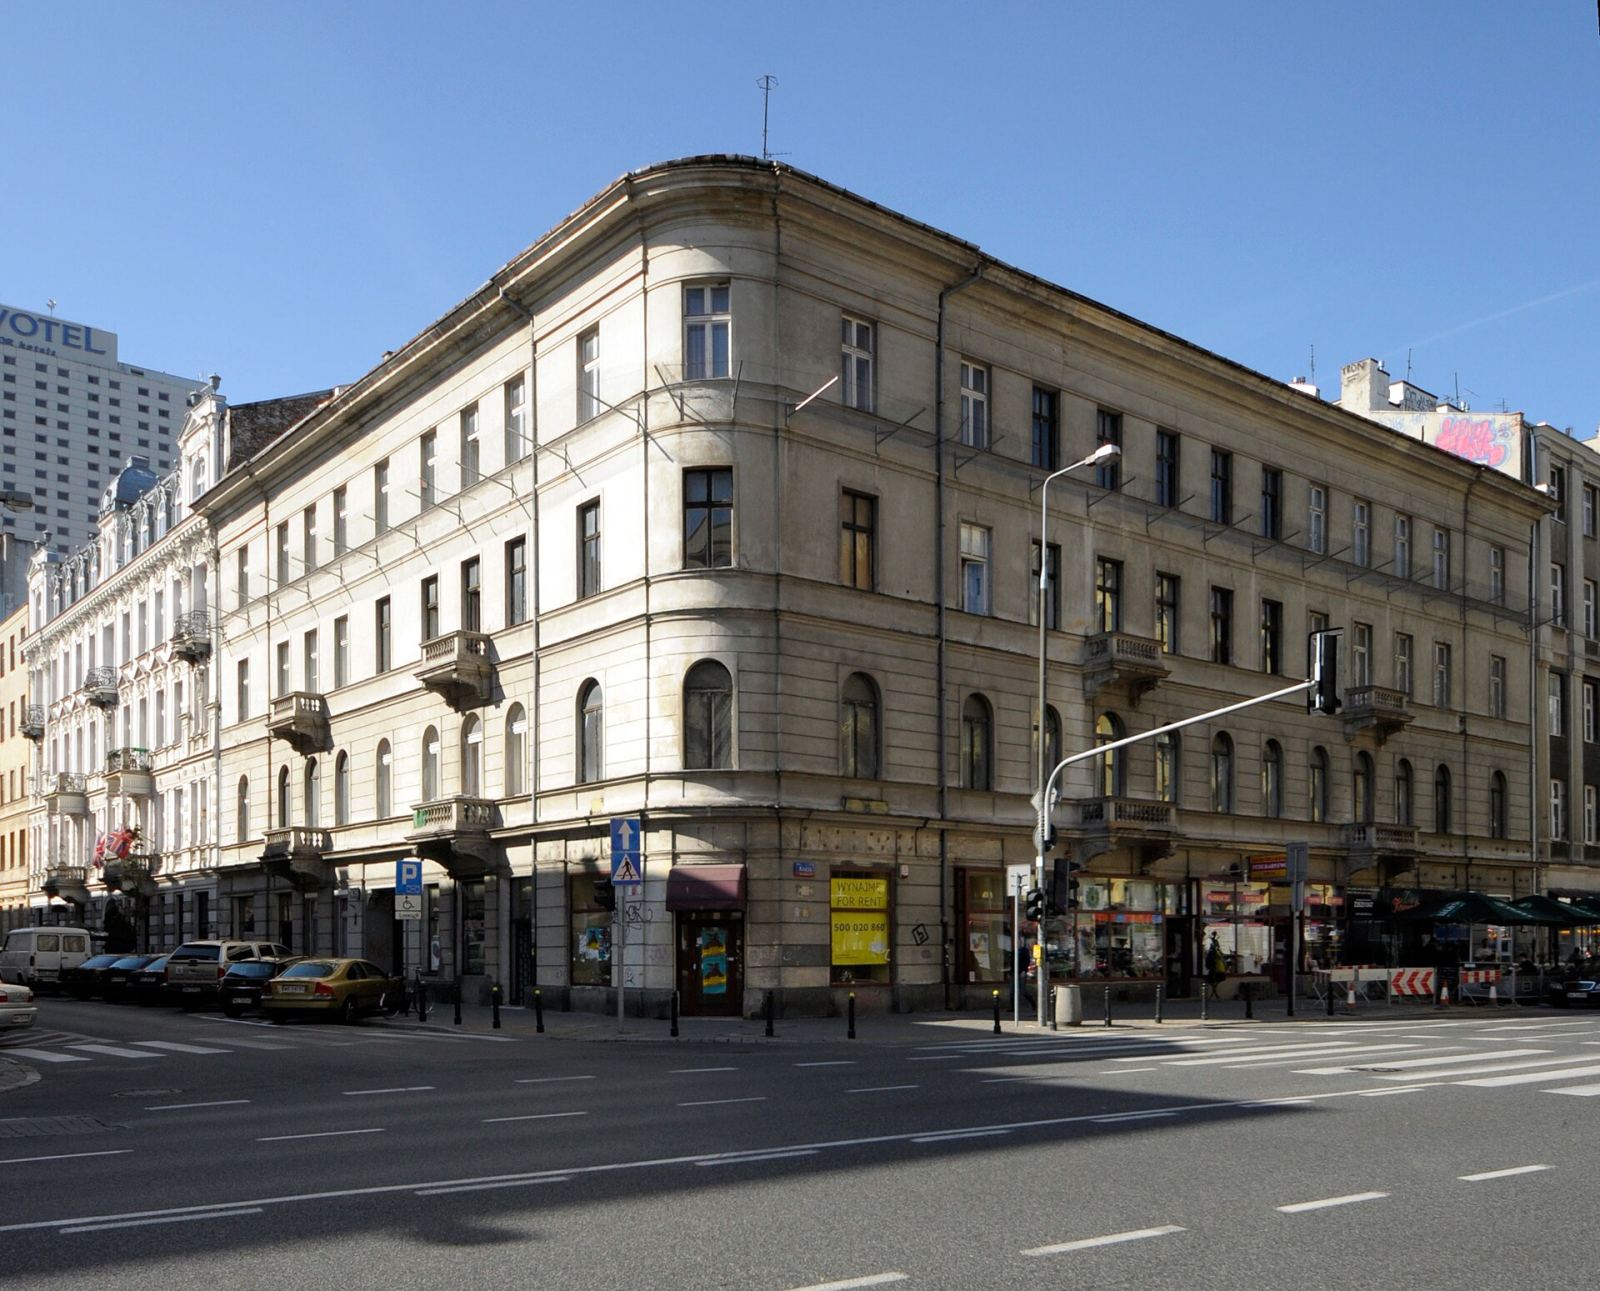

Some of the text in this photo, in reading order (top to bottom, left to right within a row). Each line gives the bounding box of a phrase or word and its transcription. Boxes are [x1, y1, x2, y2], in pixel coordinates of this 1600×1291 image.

[402, 863, 417, 885] P
[837, 896, 882, 907] FOR RENT
[834, 923, 851, 932] 500
[853, 923, 869, 932] 020
